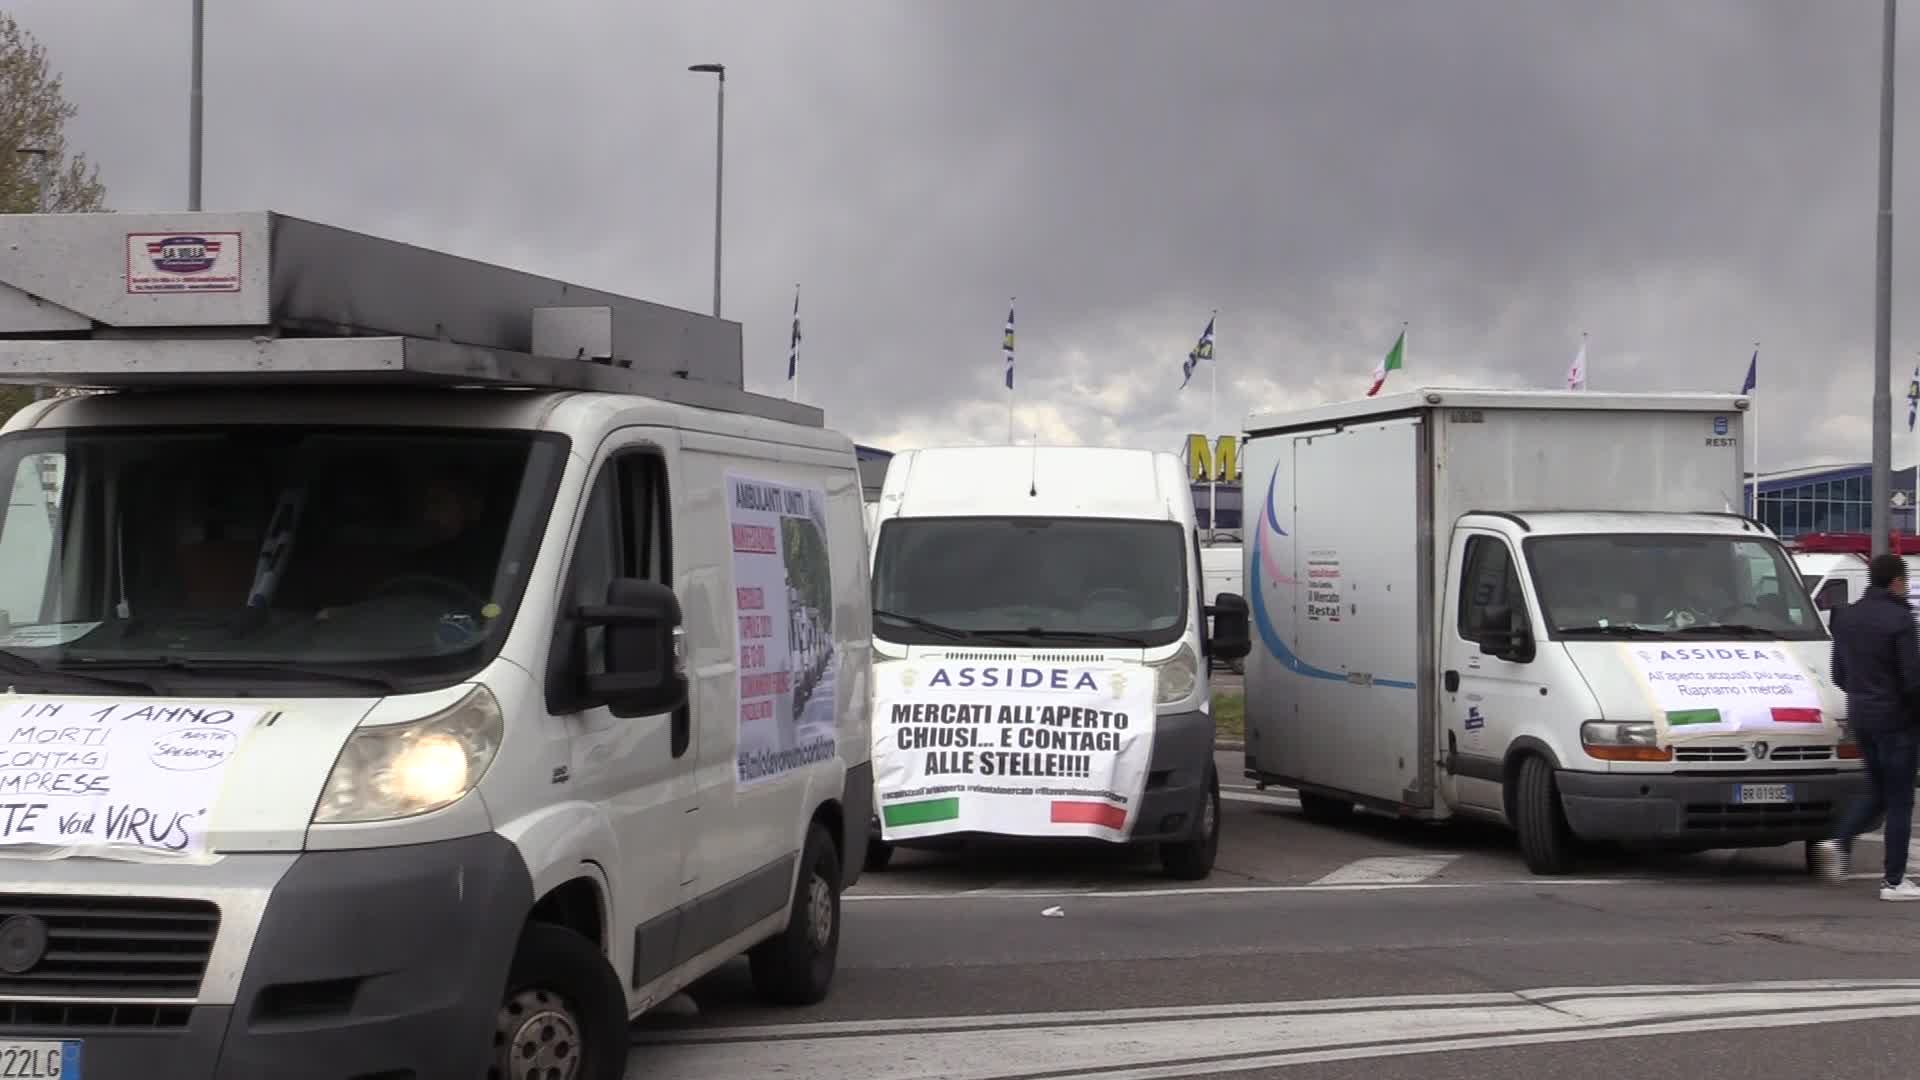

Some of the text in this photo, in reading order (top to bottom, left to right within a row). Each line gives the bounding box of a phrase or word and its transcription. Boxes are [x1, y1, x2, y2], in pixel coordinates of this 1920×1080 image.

[1308, 604, 1340, 617] Resta!
[1660, 648, 1769, 661] ASSIDEA
[929, 668, 1099, 691] ASSIDEA
[1677, 684, 1740, 697] Riapriamo
[1749, 684, 1793, 695] mercati
[20, 703, 235, 725] IN 1 ANNO
[891, 703, 1129, 730] MERCATI ALL'APERTO
[8, 726, 112, 745] MORTI
[897, 727, 1120, 752] CHIUSI... E CONTAGI
[924, 751, 1090, 778] ALLE STELLE!!!!
[0, 772, 111, 794] MPRESE
[0, 803, 48, 837] TE
[0, 1049, 60, 1078] 22LG
